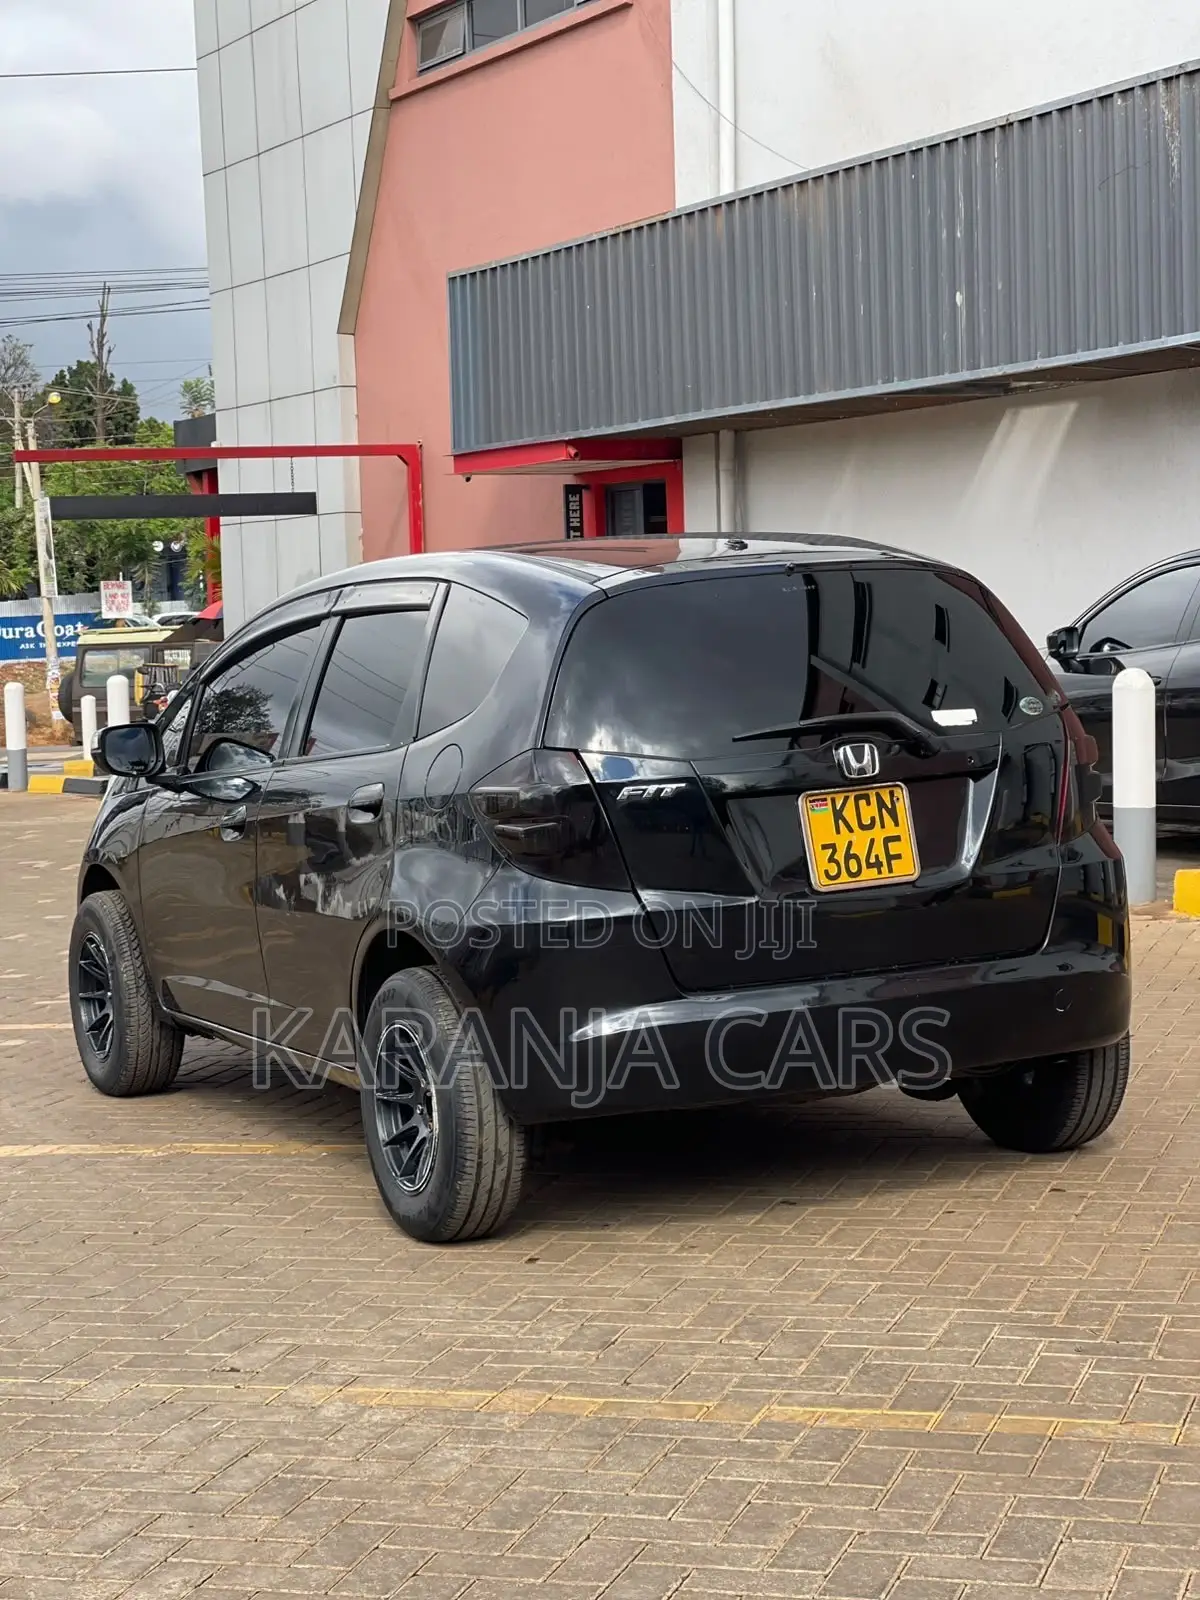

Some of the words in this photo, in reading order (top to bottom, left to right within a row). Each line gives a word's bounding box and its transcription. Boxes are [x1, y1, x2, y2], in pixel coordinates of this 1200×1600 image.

[568, 493, 581, 526] HERE
[0, 621, 84, 639] uraCoat
[616, 783, 688, 800] FIT
[830, 789, 900, 835] KCN
[821, 835, 903, 881] 364F
